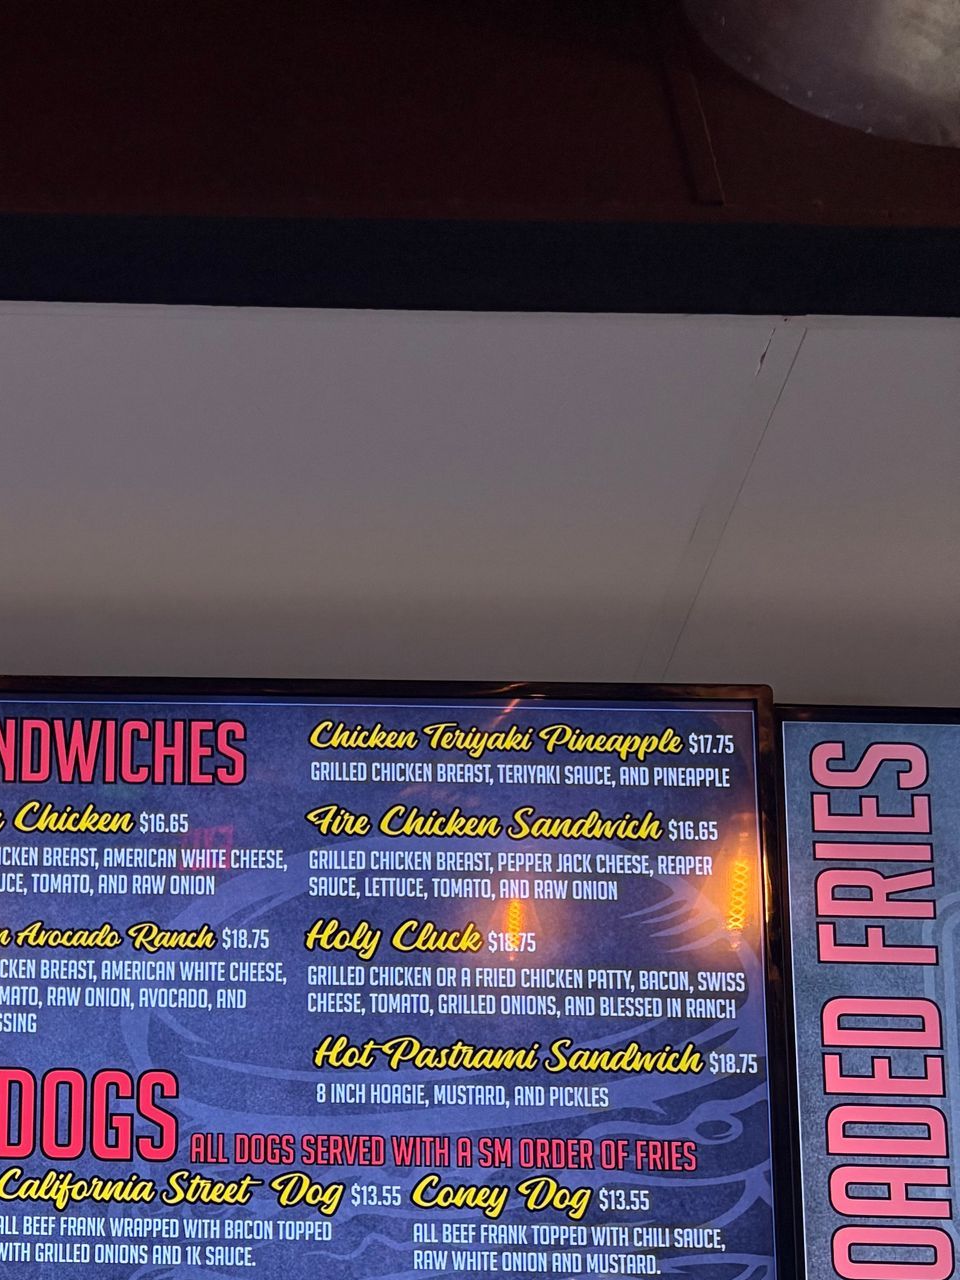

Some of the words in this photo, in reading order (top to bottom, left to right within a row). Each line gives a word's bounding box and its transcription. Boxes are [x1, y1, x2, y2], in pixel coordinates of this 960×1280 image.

[310, 721, 416, 749] Chicken
[423, 723, 531, 758] Teriyaki
[538, 724, 682, 761] Pineapple
[688, 732, 734, 755] $17.75
[310, 761, 367, 782] GRILLED
[372, 762, 432, 782] CHICKEN
[436, 763, 494, 786] BREAST,
[496, 764, 560, 784] TERIYAKI
[564, 765, 616, 788] SAUCE,
[619, 766, 650, 786] AND
[653, 767, 730, 787] PINEAPPLE
[14, 801, 132, 833] Chicken
[139, 811, 189, 834] $16.65
[42, 847, 100, 870] BREAST,
[103, 848, 177, 868] AMERICAN
[180, 848, 226, 869] WHITE
[230, 849, 288, 872] CHEESE,
[812, 744, 936, 964] FRIES
[16, 922, 121, 948] Avocado
[128, 923, 214, 952] Ranch
[222, 926, 270, 950] $18.75
[306, 919, 381, 960] Holy
[392, 920, 483, 952] Cluck
[314, 1036, 382, 1069] Hot
[380, 1037, 538, 1070] Pastrami
[544, 1039, 703, 1073] Sandwich
[709, 1050, 758, 1075] $18.75
[316, 1082, 326, 1103] 8
[330, 1083, 366, 1104] INCH
[370, 1083, 430, 1108] HOAGIE,
[434, 1084, 510, 1109] MUSTARD,
[514, 1085, 545, 1106] AND
[549, 1086, 609, 1108] PICKLES
[191, 1133, 228, 1163] ALL
[235, 1134, 294, 1164] DOGS
[302, 1135, 384, 1165] SERVED
[392, 1136, 449, 1166] WITH
[458, 1137, 471, 1166] A
[479, 1138, 512, 1167] SM
[520, 1138, 593, 1168] ORDER
[601, 1140, 628, 1169] OF
[636, 1140, 696, 1171] FRIES
[163, 1171, 261, 1205] Street
[271, 1172, 344, 1215] Dog
[351, 1182, 402, 1207] $13.55
[412, 1175, 508, 1218] Coney
[518, 1177, 591, 1220] Dog
[599, 1187, 650, 1212] $13.55
[34, 1242, 90, 1263] GRILLED
[94, 1244, 148, 1264] ONIONS
[152, 1244, 182, 1265] AND
[185, 1245, 202, 1266] 1K
[205, 1246, 256, 1267] SAUCE.
